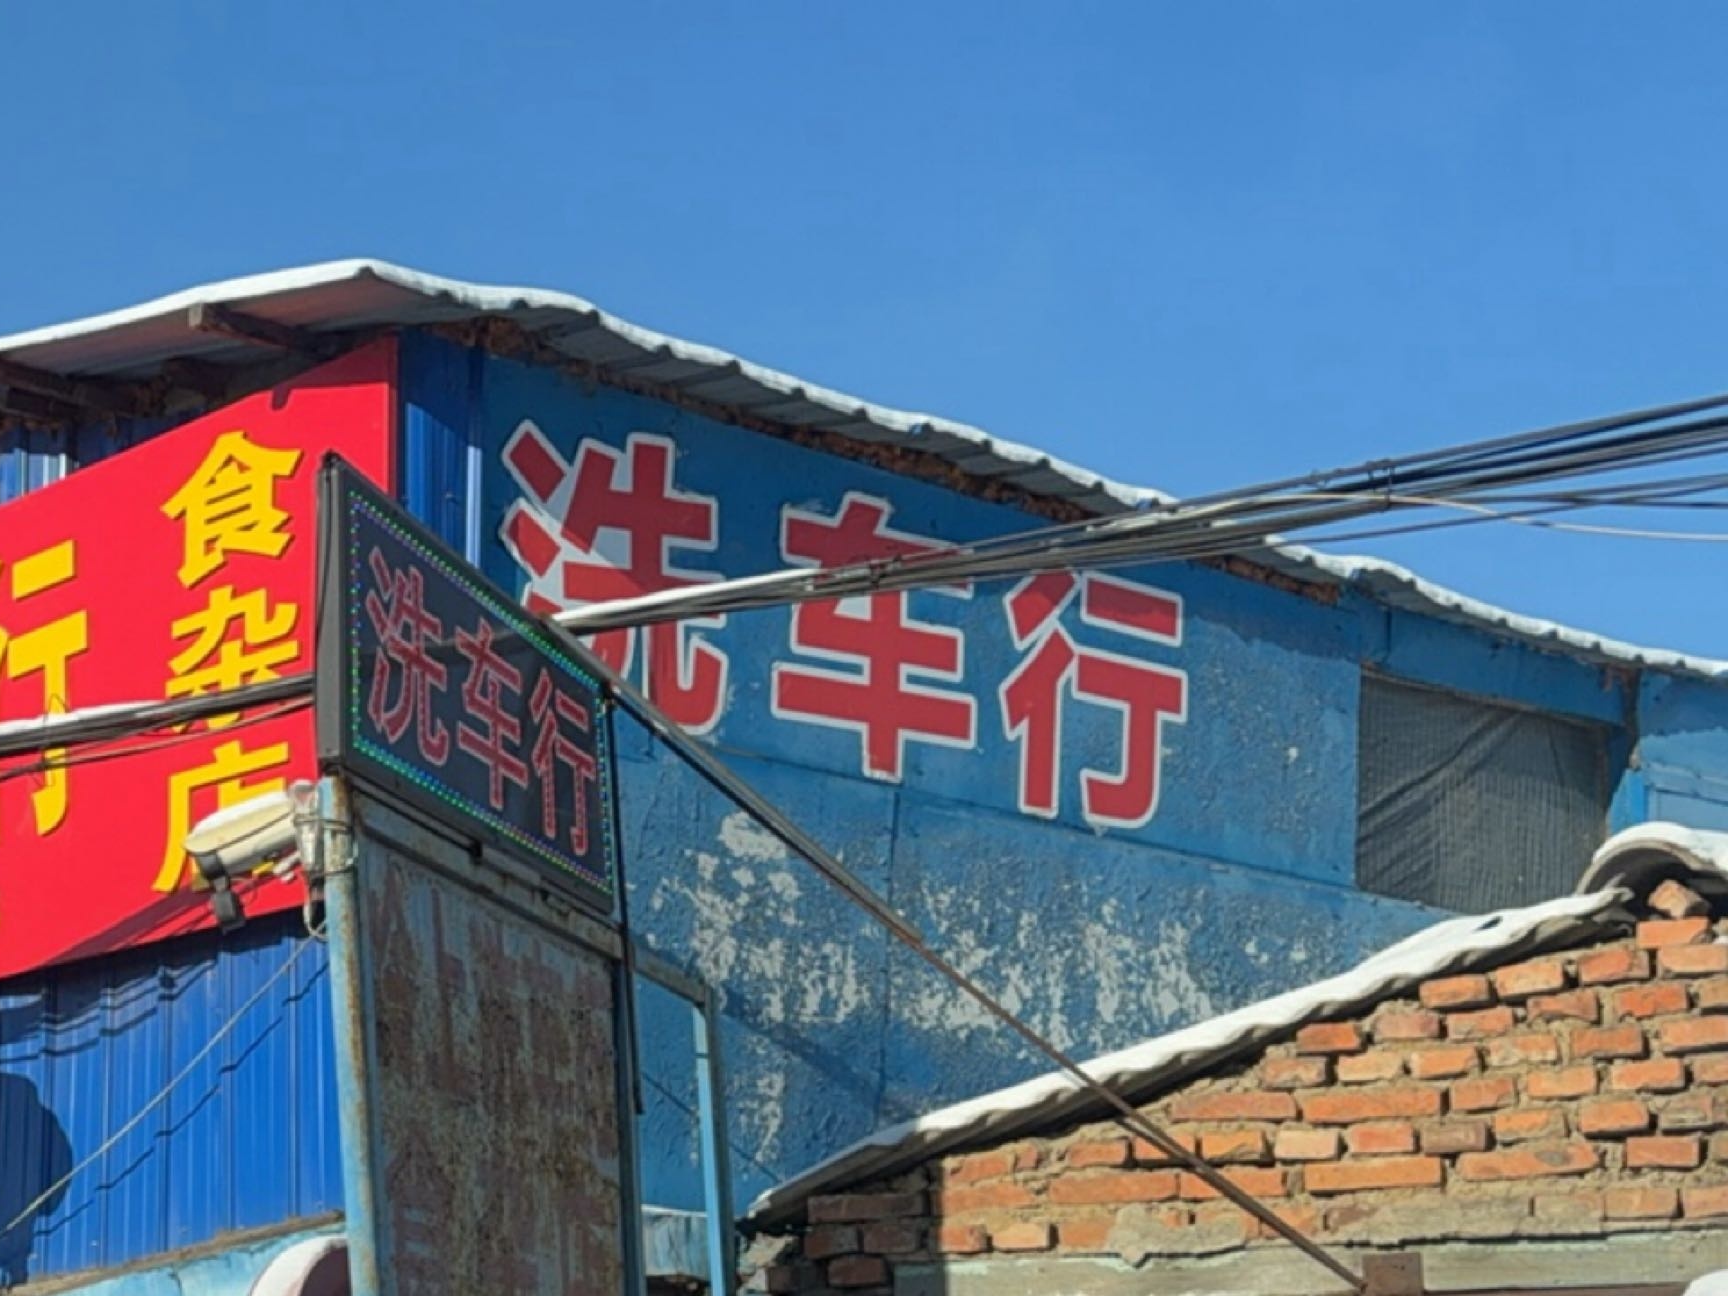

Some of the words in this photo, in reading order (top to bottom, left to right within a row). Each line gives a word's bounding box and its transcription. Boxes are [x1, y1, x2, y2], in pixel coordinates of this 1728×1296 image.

[152, 431, 305, 893] 食杂店
[365, 544, 598, 857] 洗车行
[499, 418, 1188, 830] 洗车行
